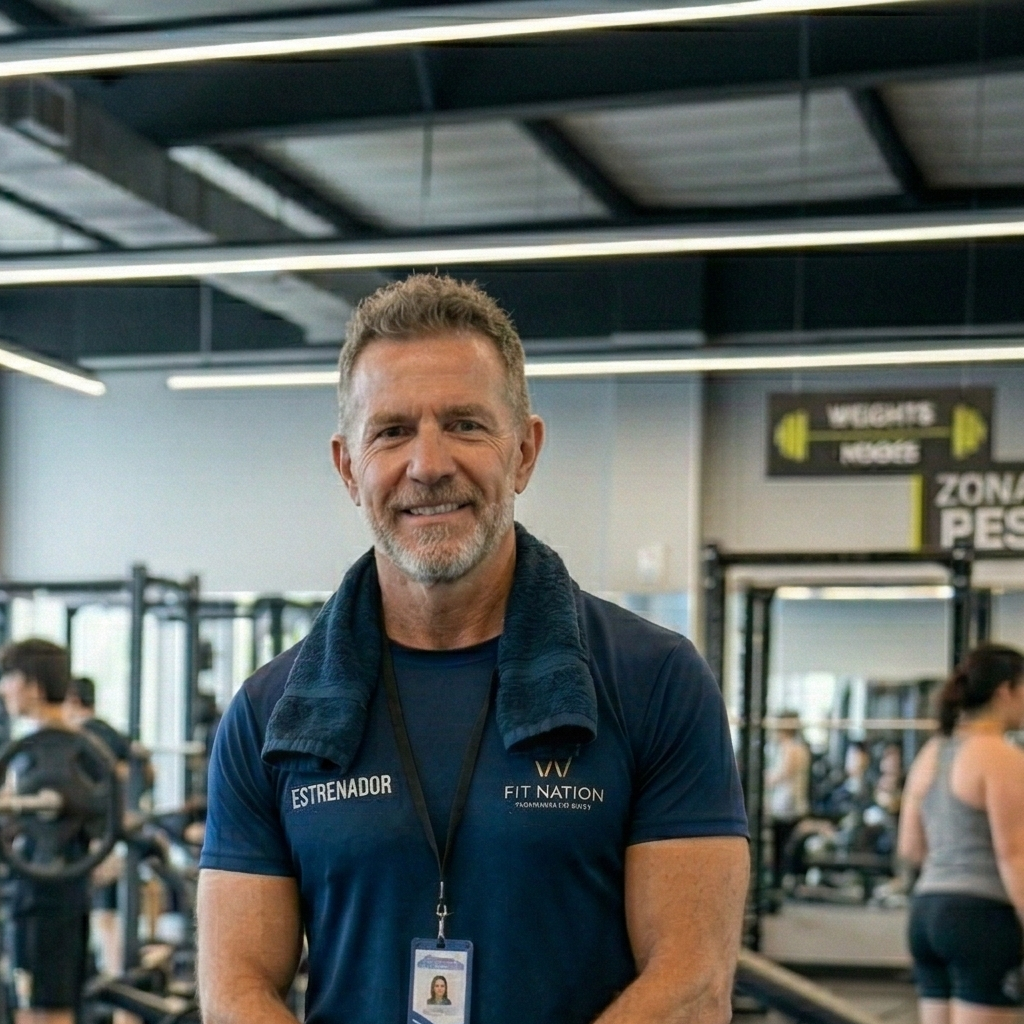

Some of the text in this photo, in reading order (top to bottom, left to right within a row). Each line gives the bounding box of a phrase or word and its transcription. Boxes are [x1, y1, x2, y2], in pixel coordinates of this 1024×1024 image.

[291, 774, 392, 810] ESTRENADOR
[504, 784, 604, 803] FIT NATION
